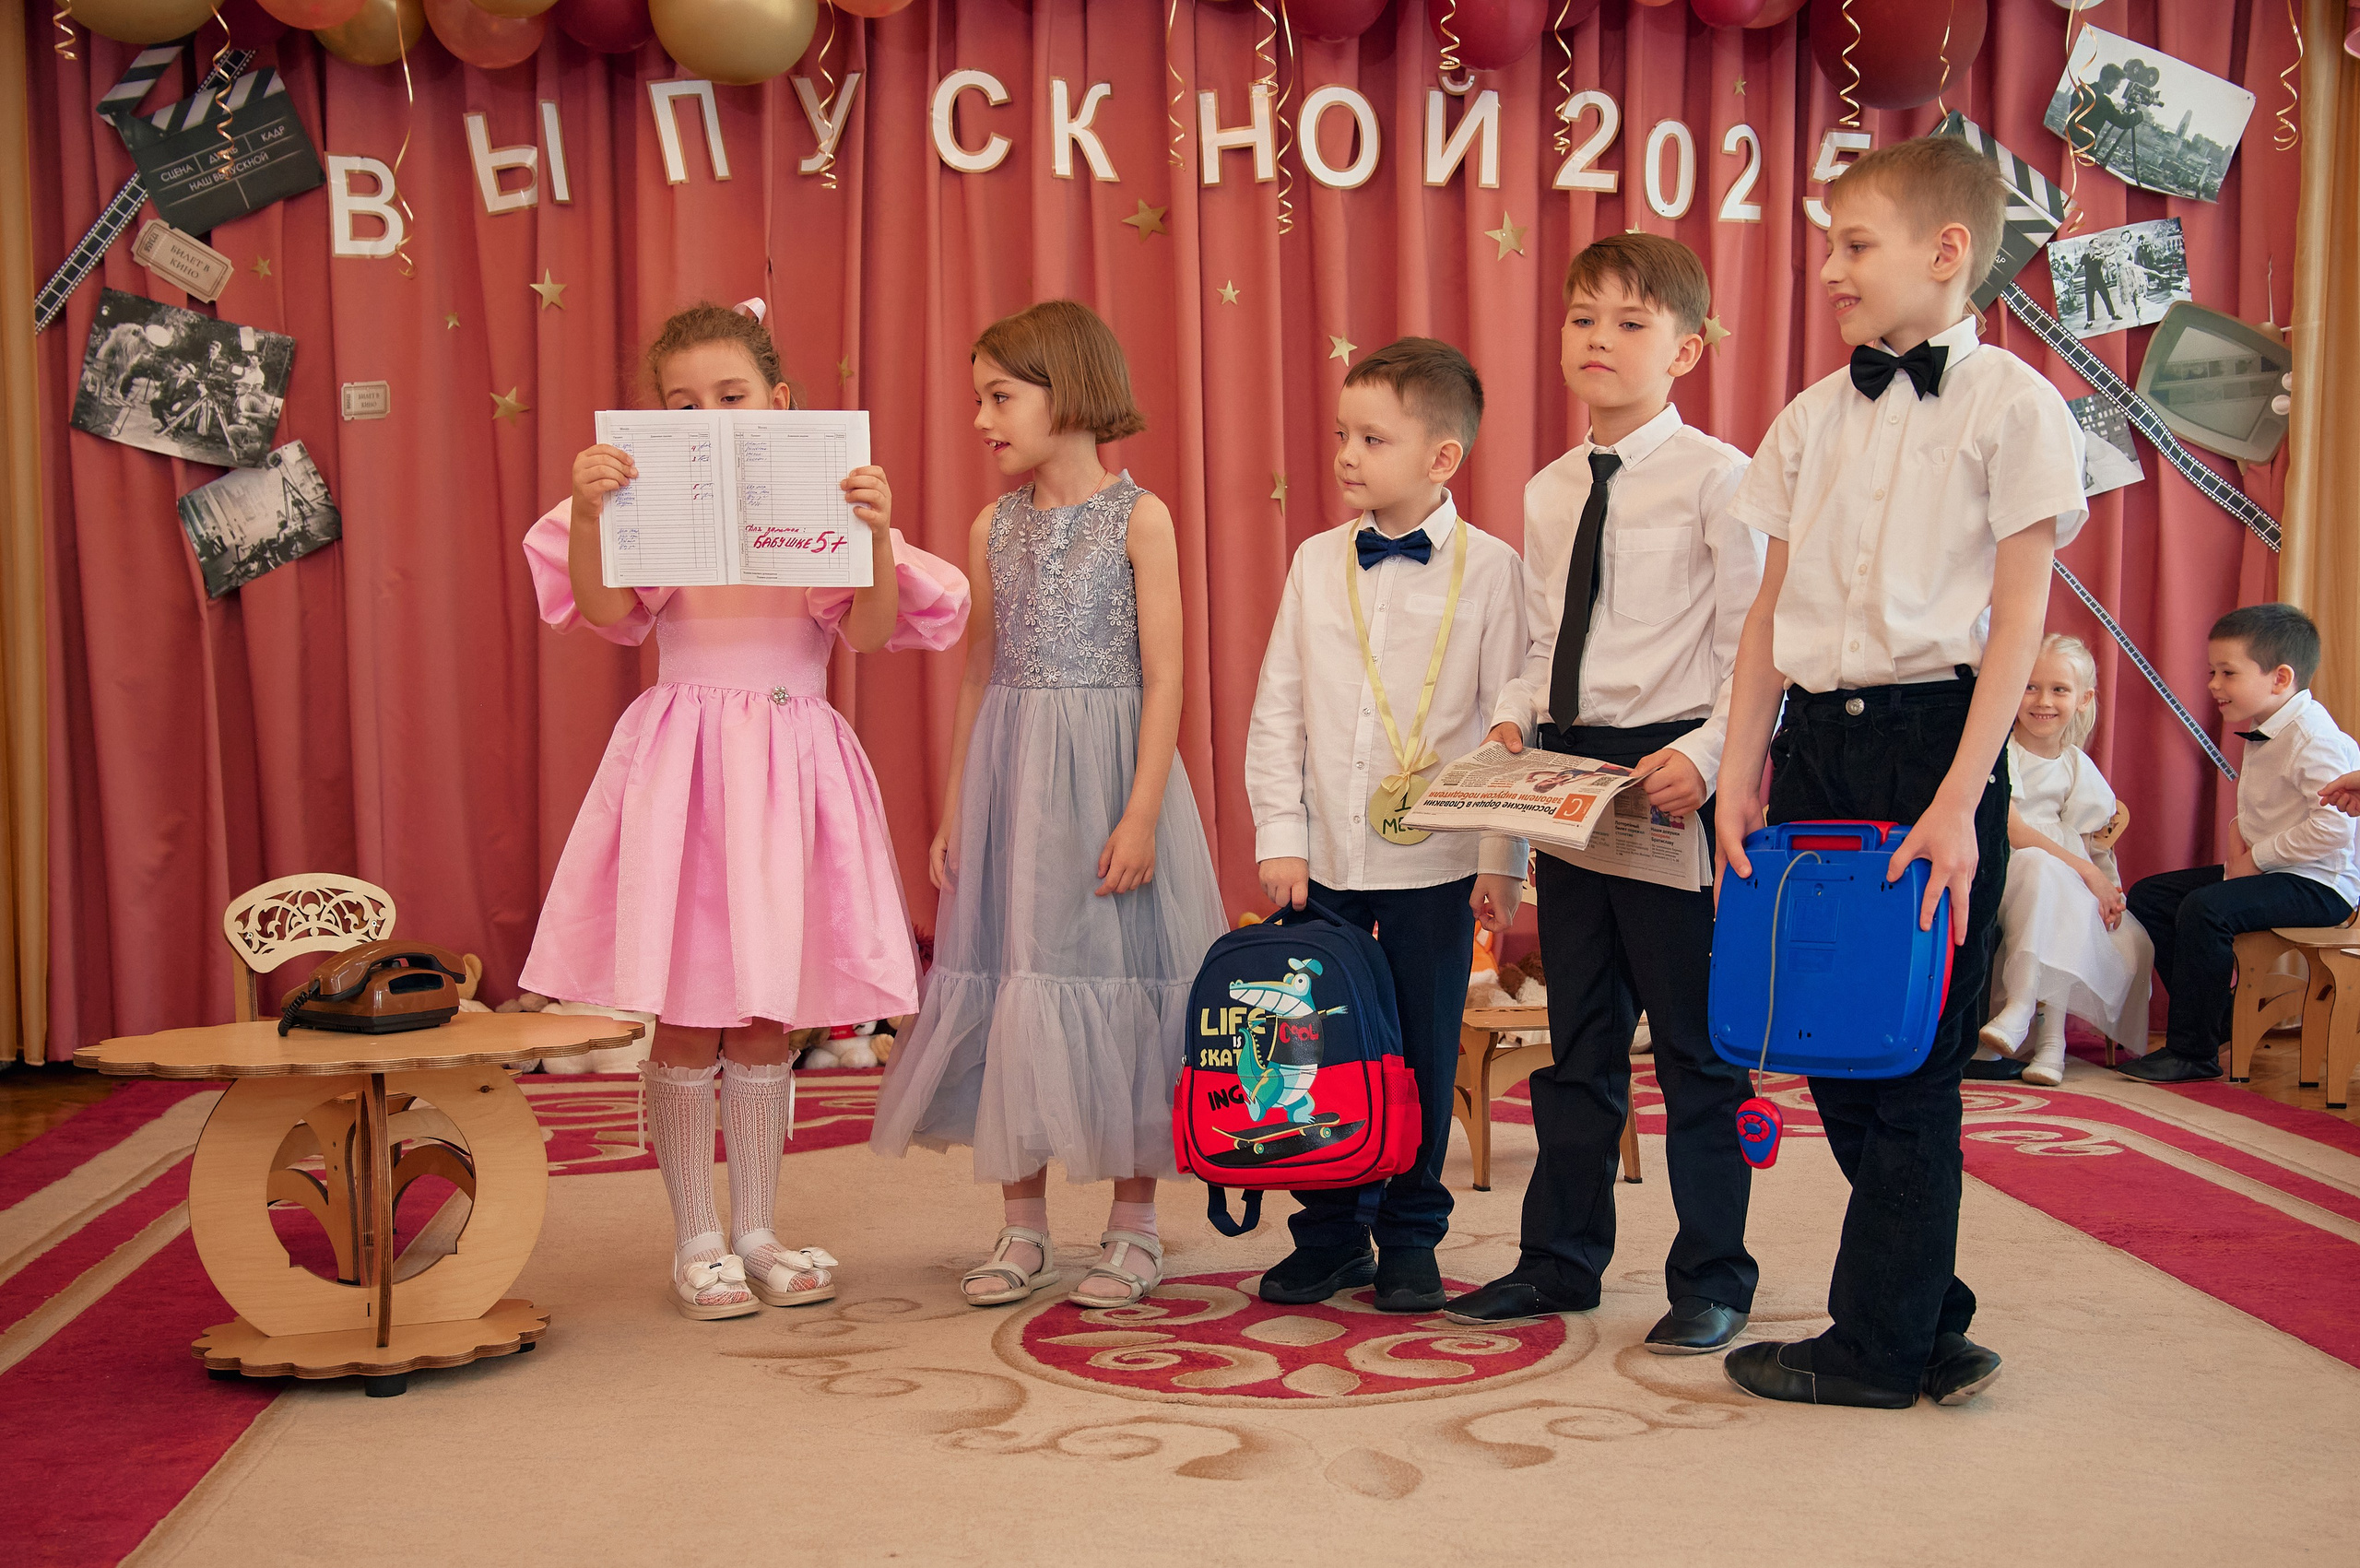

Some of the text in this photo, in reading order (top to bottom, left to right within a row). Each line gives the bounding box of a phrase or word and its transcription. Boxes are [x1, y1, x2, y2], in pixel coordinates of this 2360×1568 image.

[260, 125, 286, 142] КАДР
[189, 150, 269, 192] НАШ ВЫУСКНОЙ
[324, 68, 1874, 259] ВЫПУСКНОЙ 2025
[160, 163, 195, 183] СЦЕНА
[170, 244, 210, 273] БИЛЕТ В
[170, 258, 199, 278] КИНО
[753, 535, 813, 549] БАБУШКЕ
[1423, 799, 1465, 809] Словакии
[1428, 790, 1564, 805] заболели вирусом победителя
[1472, 799, 1502, 809] борцы
[1502, 801, 1558, 815] Российские
[1200, 1007, 1266, 1036] LIFE
[1233, 1035, 1242, 1048] IS
[1208, 1084, 1245, 1112] ING
